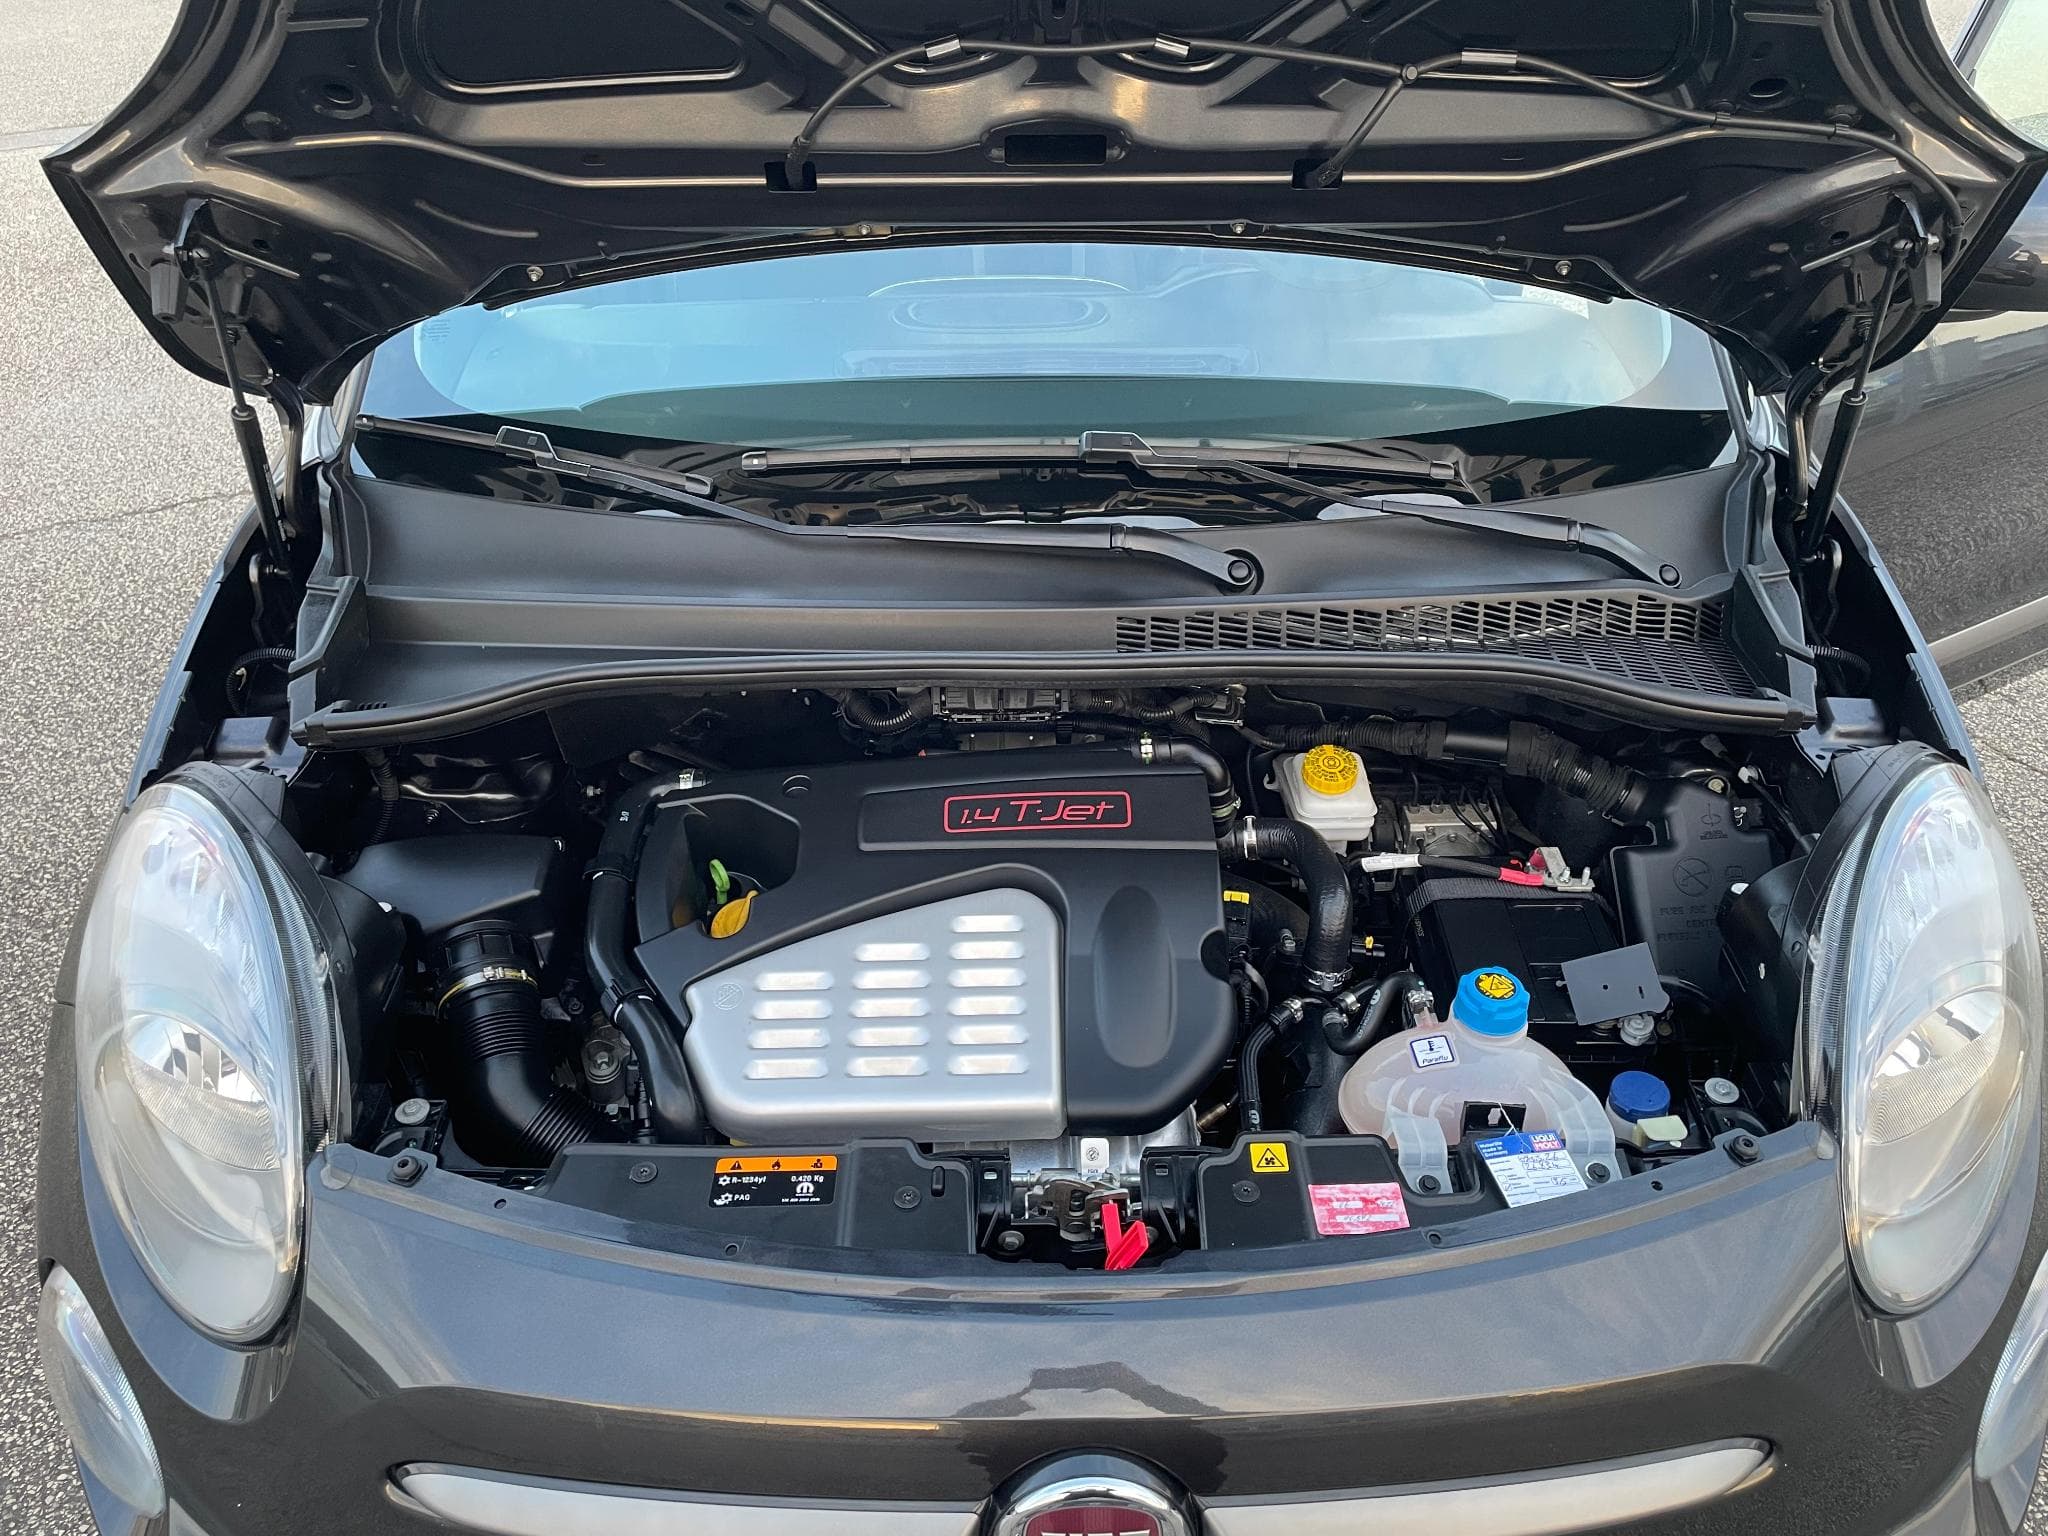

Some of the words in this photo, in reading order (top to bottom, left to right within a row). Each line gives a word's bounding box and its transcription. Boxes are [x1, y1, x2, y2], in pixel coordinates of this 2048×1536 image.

[960, 806, 1000, 824] 1.4
[1010, 799, 1114, 822] T-Jet
[1531, 1132, 1556, 1143] LIQUI
[1534, 1141, 1562, 1151] MOLY
[790, 1175, 812, 1183] 0.420
[813, 1174, 824, 1183] Kg
